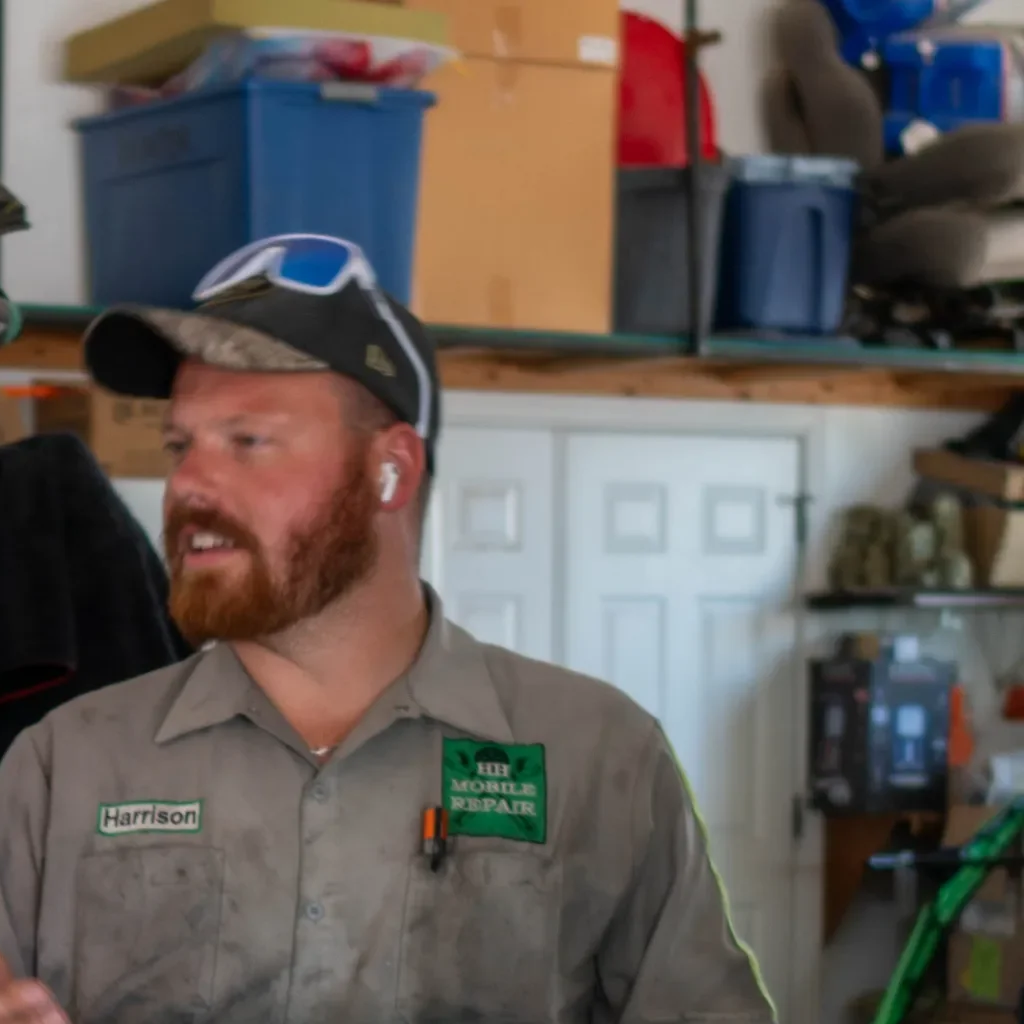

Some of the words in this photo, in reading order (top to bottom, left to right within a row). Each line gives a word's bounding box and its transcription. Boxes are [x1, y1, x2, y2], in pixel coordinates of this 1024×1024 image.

[477, 762, 510, 777] HH
[451, 779, 537, 797] MOBILE
[451, 796, 537, 816] REPAIR
[102, 805, 196, 828] Harrison
